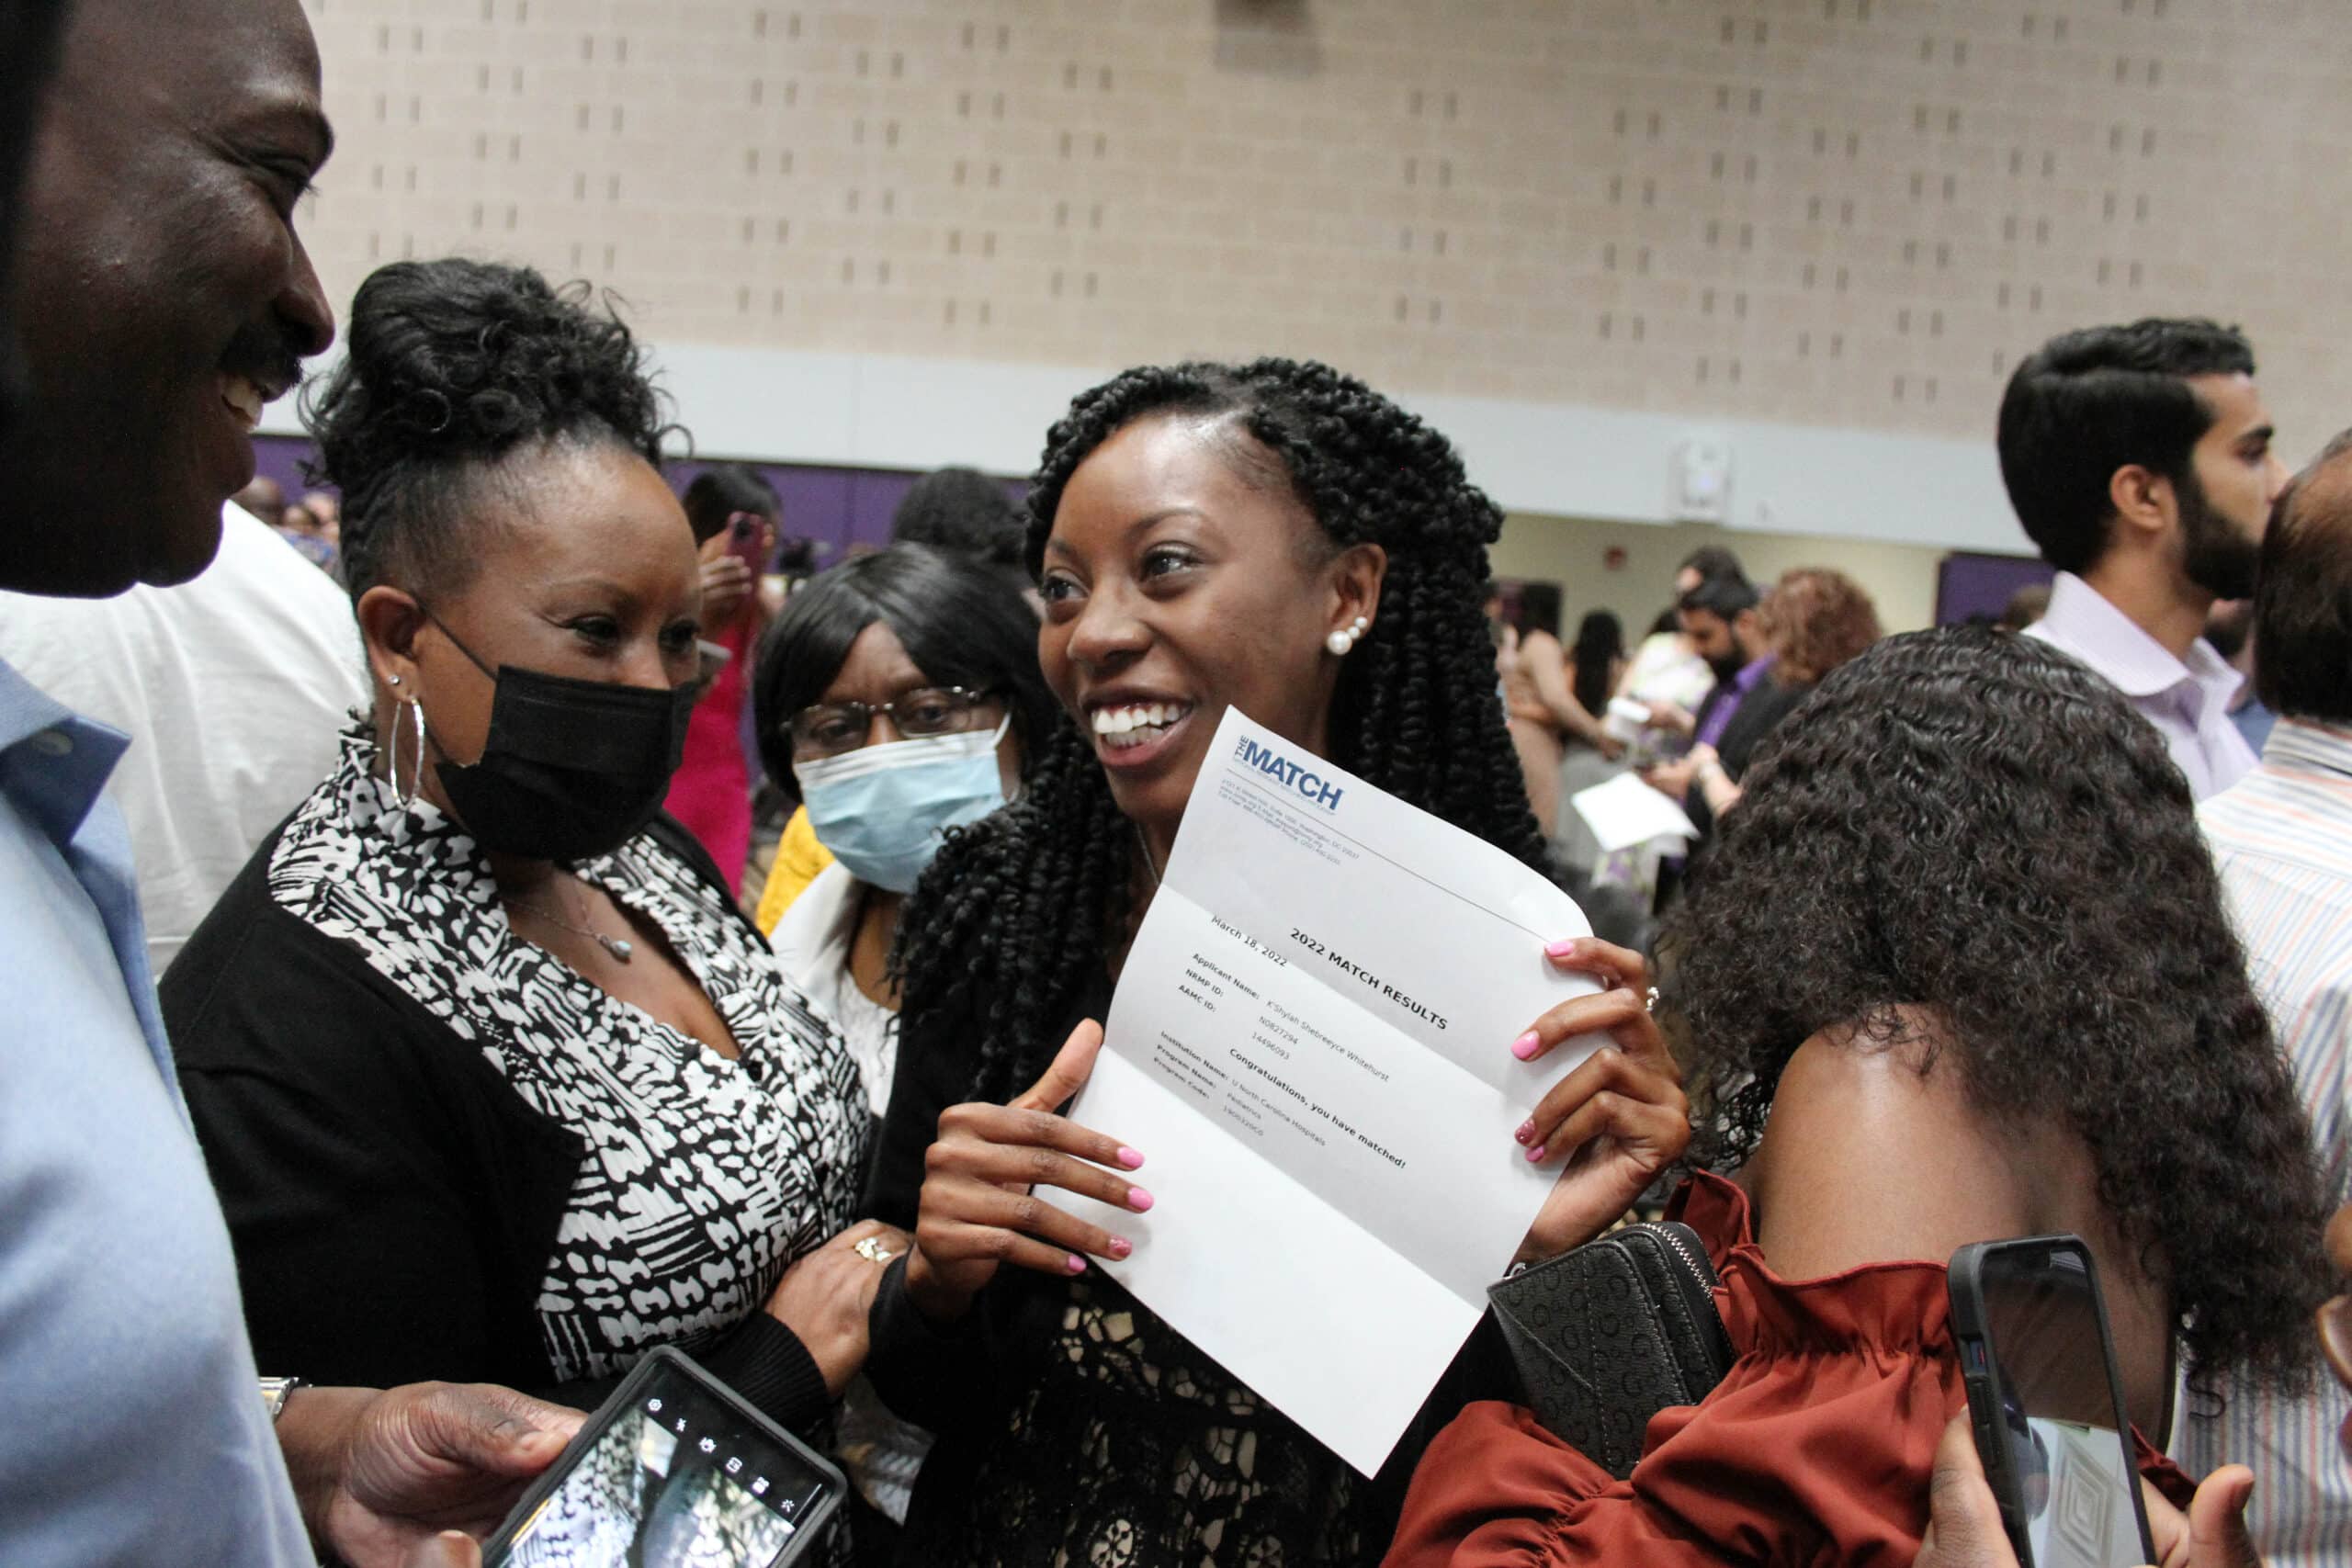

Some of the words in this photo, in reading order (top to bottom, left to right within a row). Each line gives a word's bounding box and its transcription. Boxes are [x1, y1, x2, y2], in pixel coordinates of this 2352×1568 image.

[1234, 735, 1251, 756] THE
[1243, 740, 1343, 810] MATCH
[1211, 915, 1241, 939] March
[1243, 935, 1258, 951] 18,
[1261, 947, 1286, 966] 2022
[1178, 985, 1202, 1002] AAMC
[1204, 1000, 1216, 1012] ID:
[1185, 968, 1210, 986] NRMP
[1211, 985, 1224, 997] ID:
[1290, 928, 1325, 955] 2022
[1329, 952, 1379, 988] MATCH
[1383, 985, 1447, 1029] RESULTS
[1192, 953, 1231, 981] Applicant
[1232, 977, 1260, 1000] Name:
[1346, 1050, 1389, 1081] Whitehurst
[1160, 1031, 1201, 1061] Institution
[1229, 1048, 1307, 1105] Congratulations,
[1310, 1102, 1329, 1118] you
[1331, 1115, 1355, 1135] have
[1358, 1134, 1406, 1168] matched!
